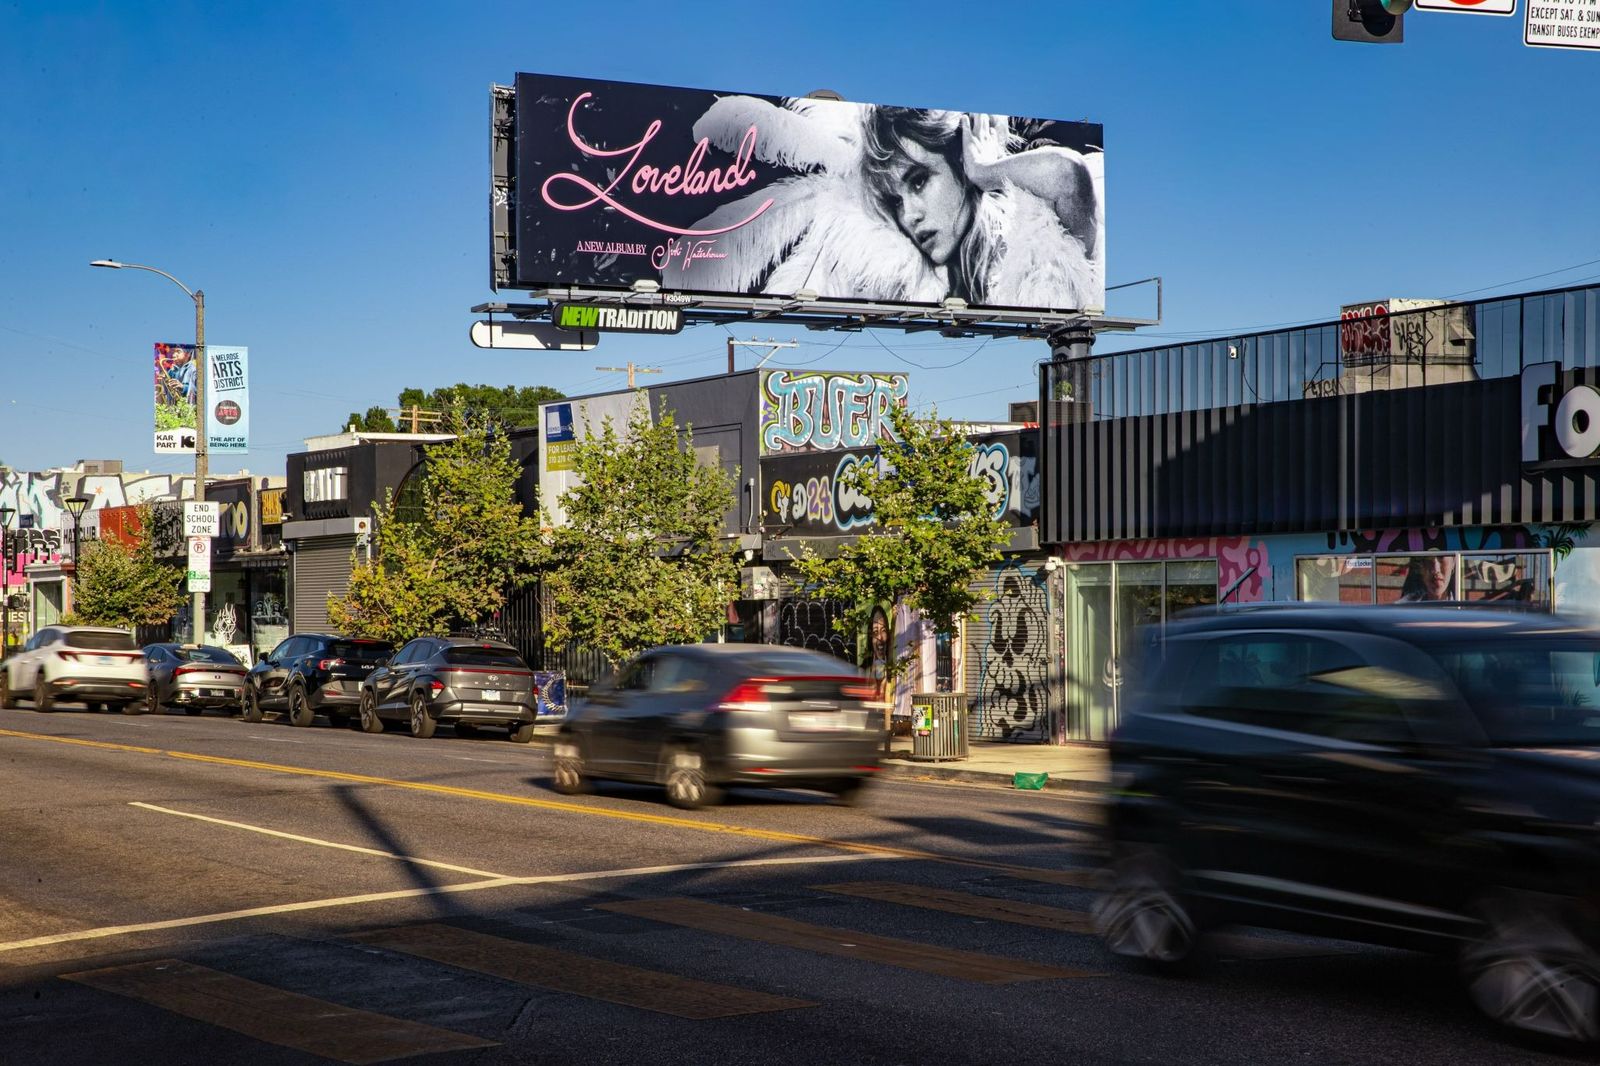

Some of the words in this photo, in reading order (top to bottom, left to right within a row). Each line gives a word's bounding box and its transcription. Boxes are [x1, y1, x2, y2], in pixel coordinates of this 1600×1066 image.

[1531, 7, 1558, 20] EXCEPT
[1577, 10, 1584, 22] &
[1529, 23, 1555, 36] TRANSIT
[1557, 25, 1578, 38] BUSES
[542, 92, 775, 236] Loveland
[576, 240, 585, 251] A
[585, 241, 604, 252] NEW
[606, 242, 635, 254] ALBUM
[636, 244, 647, 254] BY
[215, 352, 240, 362] MELROSE
[213, 361, 243, 379] ARTS
[213, 376, 244, 389] DISTRICT
[156, 441, 177, 449] PART
[194, 504, 210, 513] END
[186, 514, 217, 523] SCHOOL
[191, 525, 212, 534] ZONE
